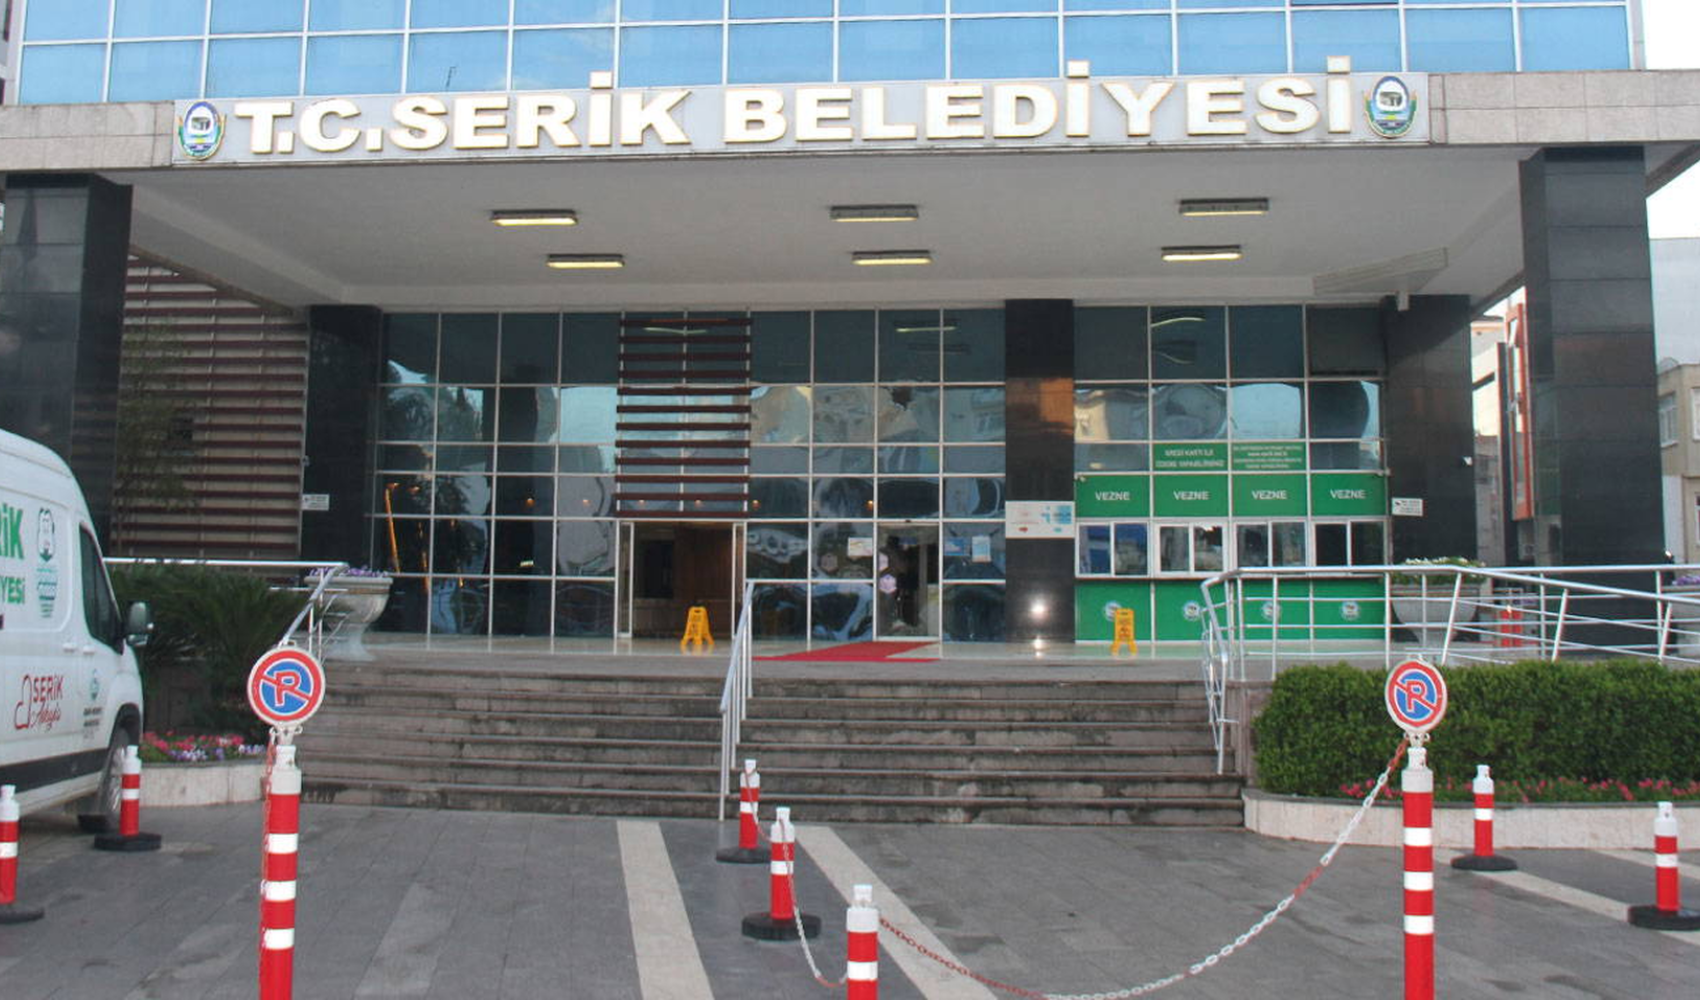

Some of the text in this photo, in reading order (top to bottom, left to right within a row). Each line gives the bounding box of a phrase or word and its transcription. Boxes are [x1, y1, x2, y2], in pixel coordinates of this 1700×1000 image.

[723, 55, 1351, 144] BELEDİYESİ
[1094, 490, 1131, 501] VEZNE
[1173, 490, 1210, 500] VEZNE
[1252, 489, 1288, 500] VEZNE
[1329, 488, 1366, 499] VEZNE
